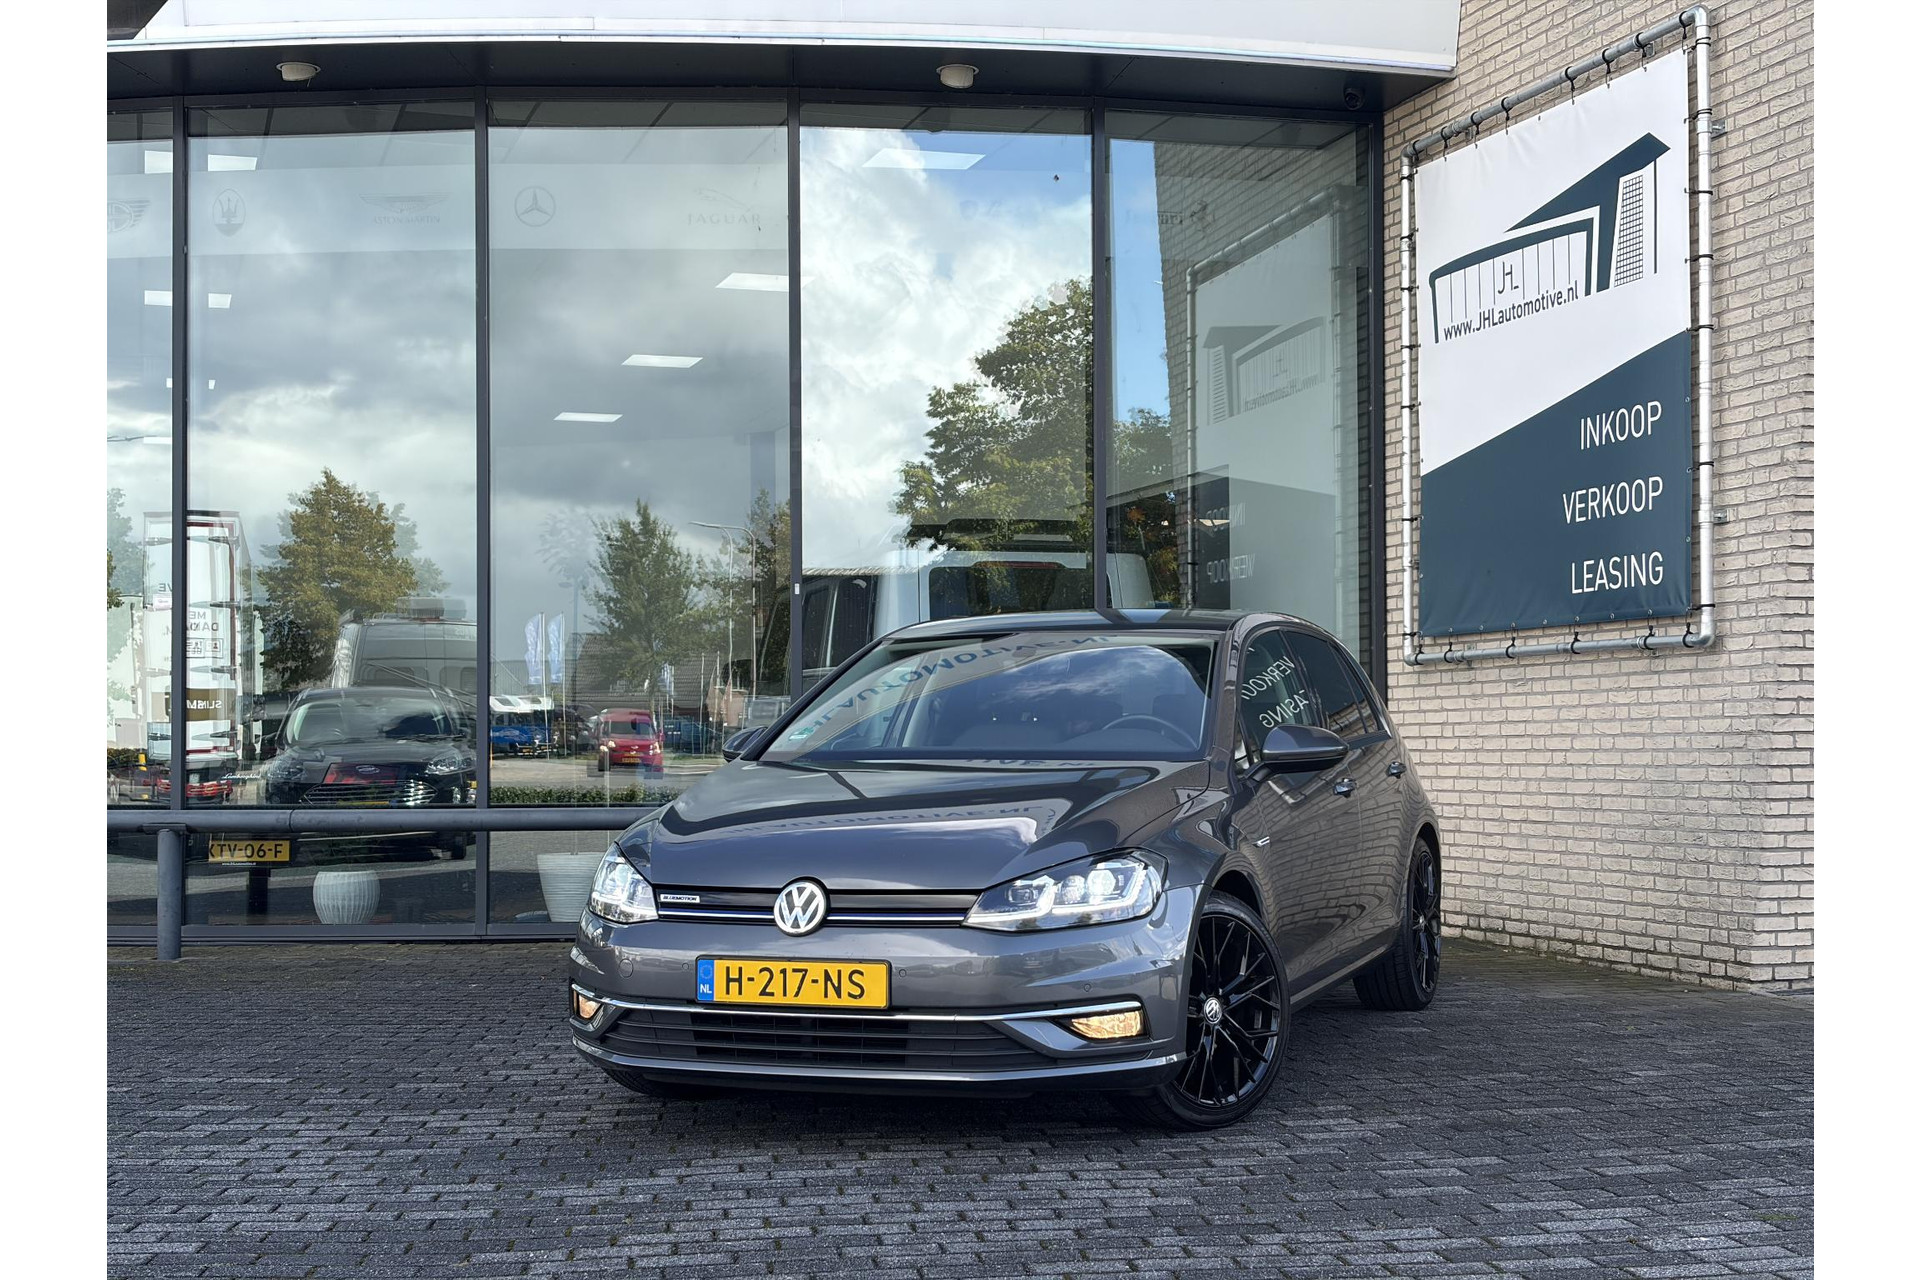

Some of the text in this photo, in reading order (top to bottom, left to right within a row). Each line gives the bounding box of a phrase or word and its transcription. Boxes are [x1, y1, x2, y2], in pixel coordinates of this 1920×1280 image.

[687, 213, 760, 225] JAGUAR
[1443, 280, 1578, 341] www.JHLautomotive.nl
[1580, 400, 1662, 450] INKOOP
[1563, 476, 1663, 524] VERKOOP
[1571, 551, 1664, 594] LEASING
[700, 983, 713, 994] NL
[725, 965, 866, 1001] H-217-NS
